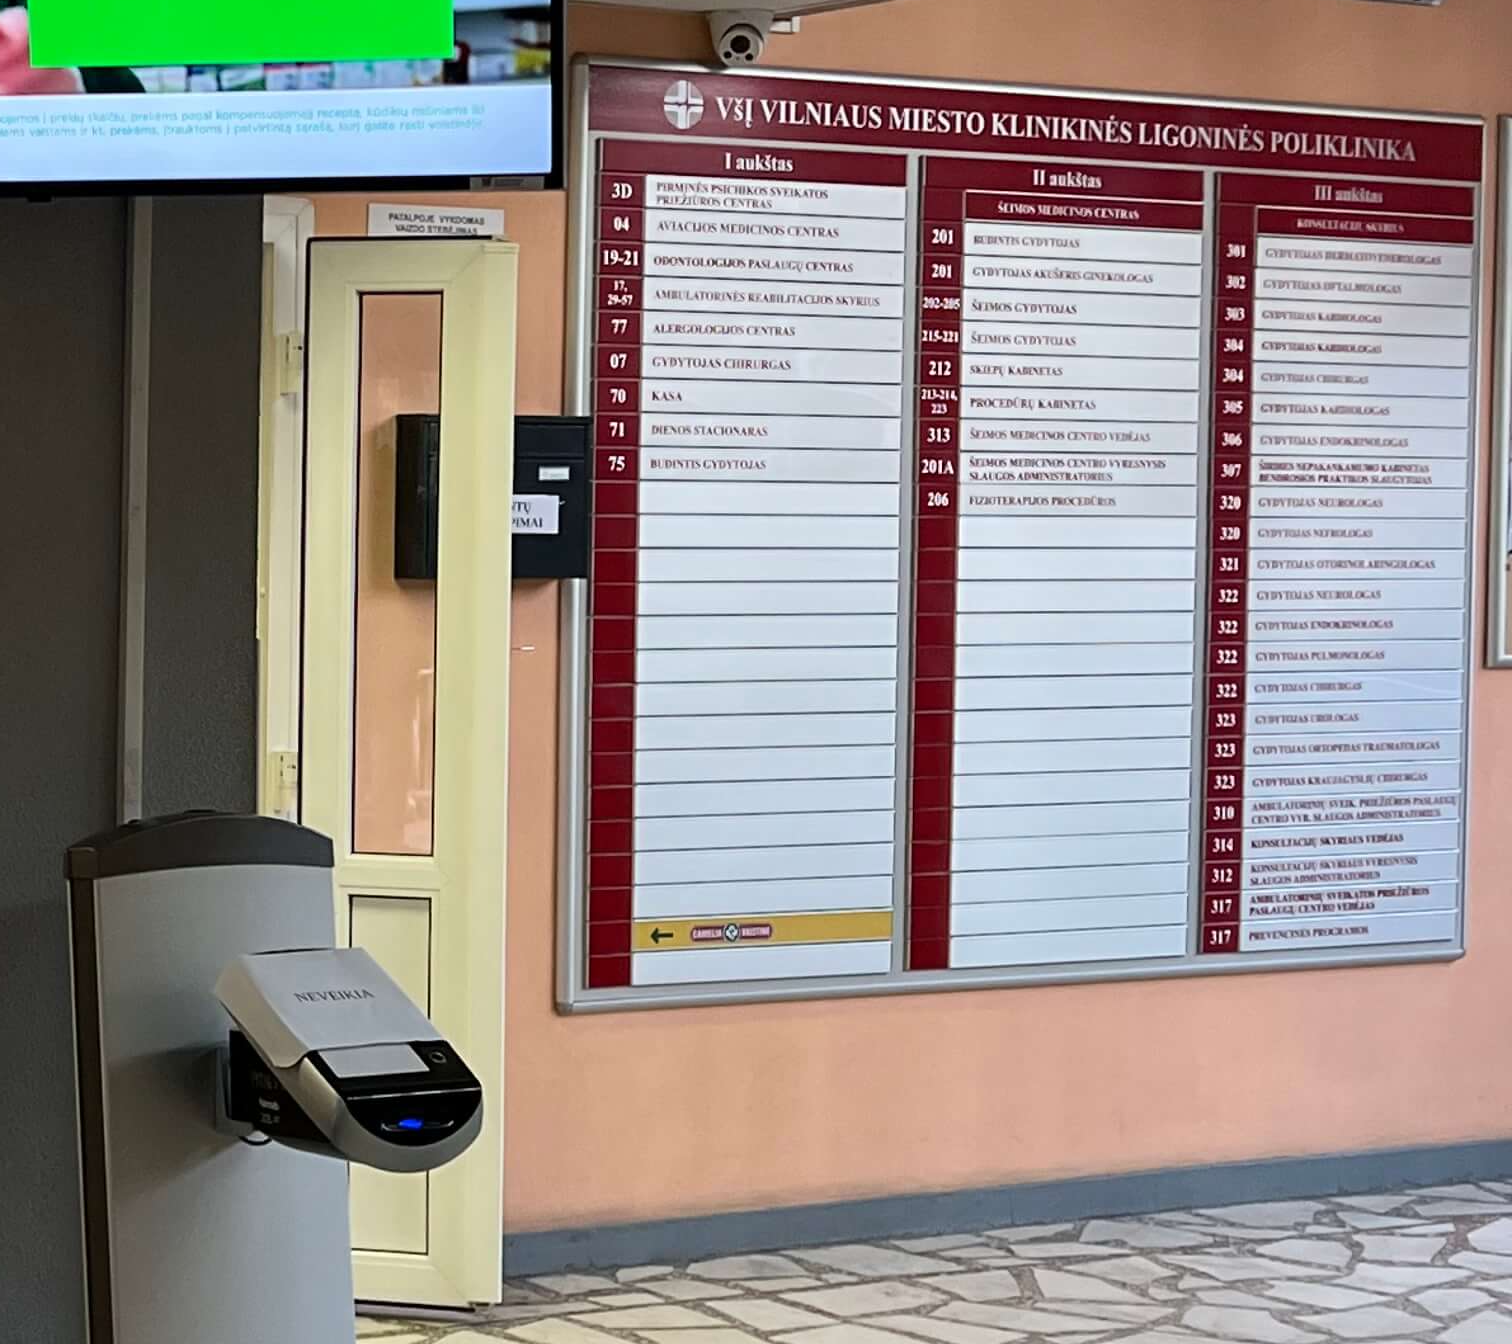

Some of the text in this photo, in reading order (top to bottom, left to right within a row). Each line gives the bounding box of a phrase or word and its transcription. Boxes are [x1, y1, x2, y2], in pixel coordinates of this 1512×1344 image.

[715, 97, 1414, 160] VšĮ VILNIAUS MIESTO KLINIKINĖS LIGONINĖS POLIKLINIKA
[725, 152, 793, 171] I aukštas
[1033, 169, 1101, 188] II aukštas
[611, 182, 632, 199] 3D
[656, 182, 828, 199] PIRMINĖS PSICHIKOS SVEIKATOS
[1314, 184, 1332, 200] III
[723, 197, 772, 208] CENTRAS
[997, 200, 1139, 219] ŠEIMOS MEDICINOS CENTRAS
[388, 212, 484, 225] PATALPOJE VYKDOMAS
[613, 216, 629, 231] 04
[395, 224, 425, 232] VAIZDO
[658, 220, 839, 237] AVIACIJOS MEDICINOS CENTRAS
[932, 228, 953, 244] 201
[973, 234, 1079, 248] BUDINTIS GYDYTOJAS
[603, 249, 638, 265] 19-21
[653, 255, 853, 272] ODONTOLOGIJOS PASLAUGŲ CENTRAS
[931, 263, 951, 278] 201
[972, 266, 1153, 283] GYDYTOJAS AKUŠERIS GINEKOLOGAS
[1225, 275, 1245, 289] 302
[655, 289, 880, 306] AMBULATORINĖS REABILITACIJOS SKYRIUS
[971, 298, 1077, 314] ŠEIMOS GYDYTOJAS
[1224, 307, 1245, 320] 303
[611, 318, 627, 333] 77
[654, 324, 795, 336] ALERGOLOGIJOS CENTRAS
[921, 330, 959, 343] 215-221
[971, 331, 1076, 346] ŠEIMOS GYDYTOJAS
[1223, 338, 1243, 352] 304
[610, 353, 626, 368] 07
[652, 356, 791, 370] GYDYTOJAS CHIRURGAS
[928, 360, 951, 375] 212
[970, 365, 1062, 376] SKIEPŲ KABINETAS
[1222, 368, 1243, 382] 304
[610, 388, 626, 403] 70
[652, 391, 681, 401] KASA
[931, 403, 947, 414] 223
[969, 397, 1096, 410] PROCEDŪRŲ KABINETAS
[1222, 399, 1243, 414] 305
[609, 421, 624, 437] 71
[651, 425, 767, 436] DIENOS STACIONARAS
[927, 427, 950, 442] 313
[970, 427, 1007, 439] ŠEIMOS
[1010, 430, 1065, 440] MEDICINOS
[1067, 431, 1107, 440] CENTRO
[1221, 432, 1242, 446] 306
[608, 455, 625, 471] 75
[650, 459, 766, 469] BUDINTIS GYDYTOJAS
[921, 458, 954, 474] 201A
[969, 455, 1166, 468] ŠEIMOS MEDICINOS CENTRO VYRESNYSIS
[969, 471, 1112, 481] SLAUGOS ADMINISTRATORIUS
[1220, 463, 1241, 477] 307
[927, 492, 948, 506] 206
[969, 495, 1116, 506] FIZIOTERAPIJOS PROCEDŪROS
[1219, 495, 1241, 509] 320
[1219, 526, 1240, 540] 320
[1219, 557, 1238, 571] 321
[1218, 589, 1238, 602] 322
[1218, 620, 1237, 634] 322
[1216, 649, 1237, 664] 322
[1215, 683, 1237, 698] 322
[1215, 713, 1235, 727] 323
[1214, 743, 1235, 757] 323
[1214, 774, 1235, 789] 323
[1213, 806, 1234, 820] 310
[1212, 837, 1233, 852] 314
[1212, 868, 1232, 882] 312
[1211, 898, 1232, 913] 317
[1210, 929, 1231, 944] 317
[293, 989, 374, 1002] NEVEIKIA
